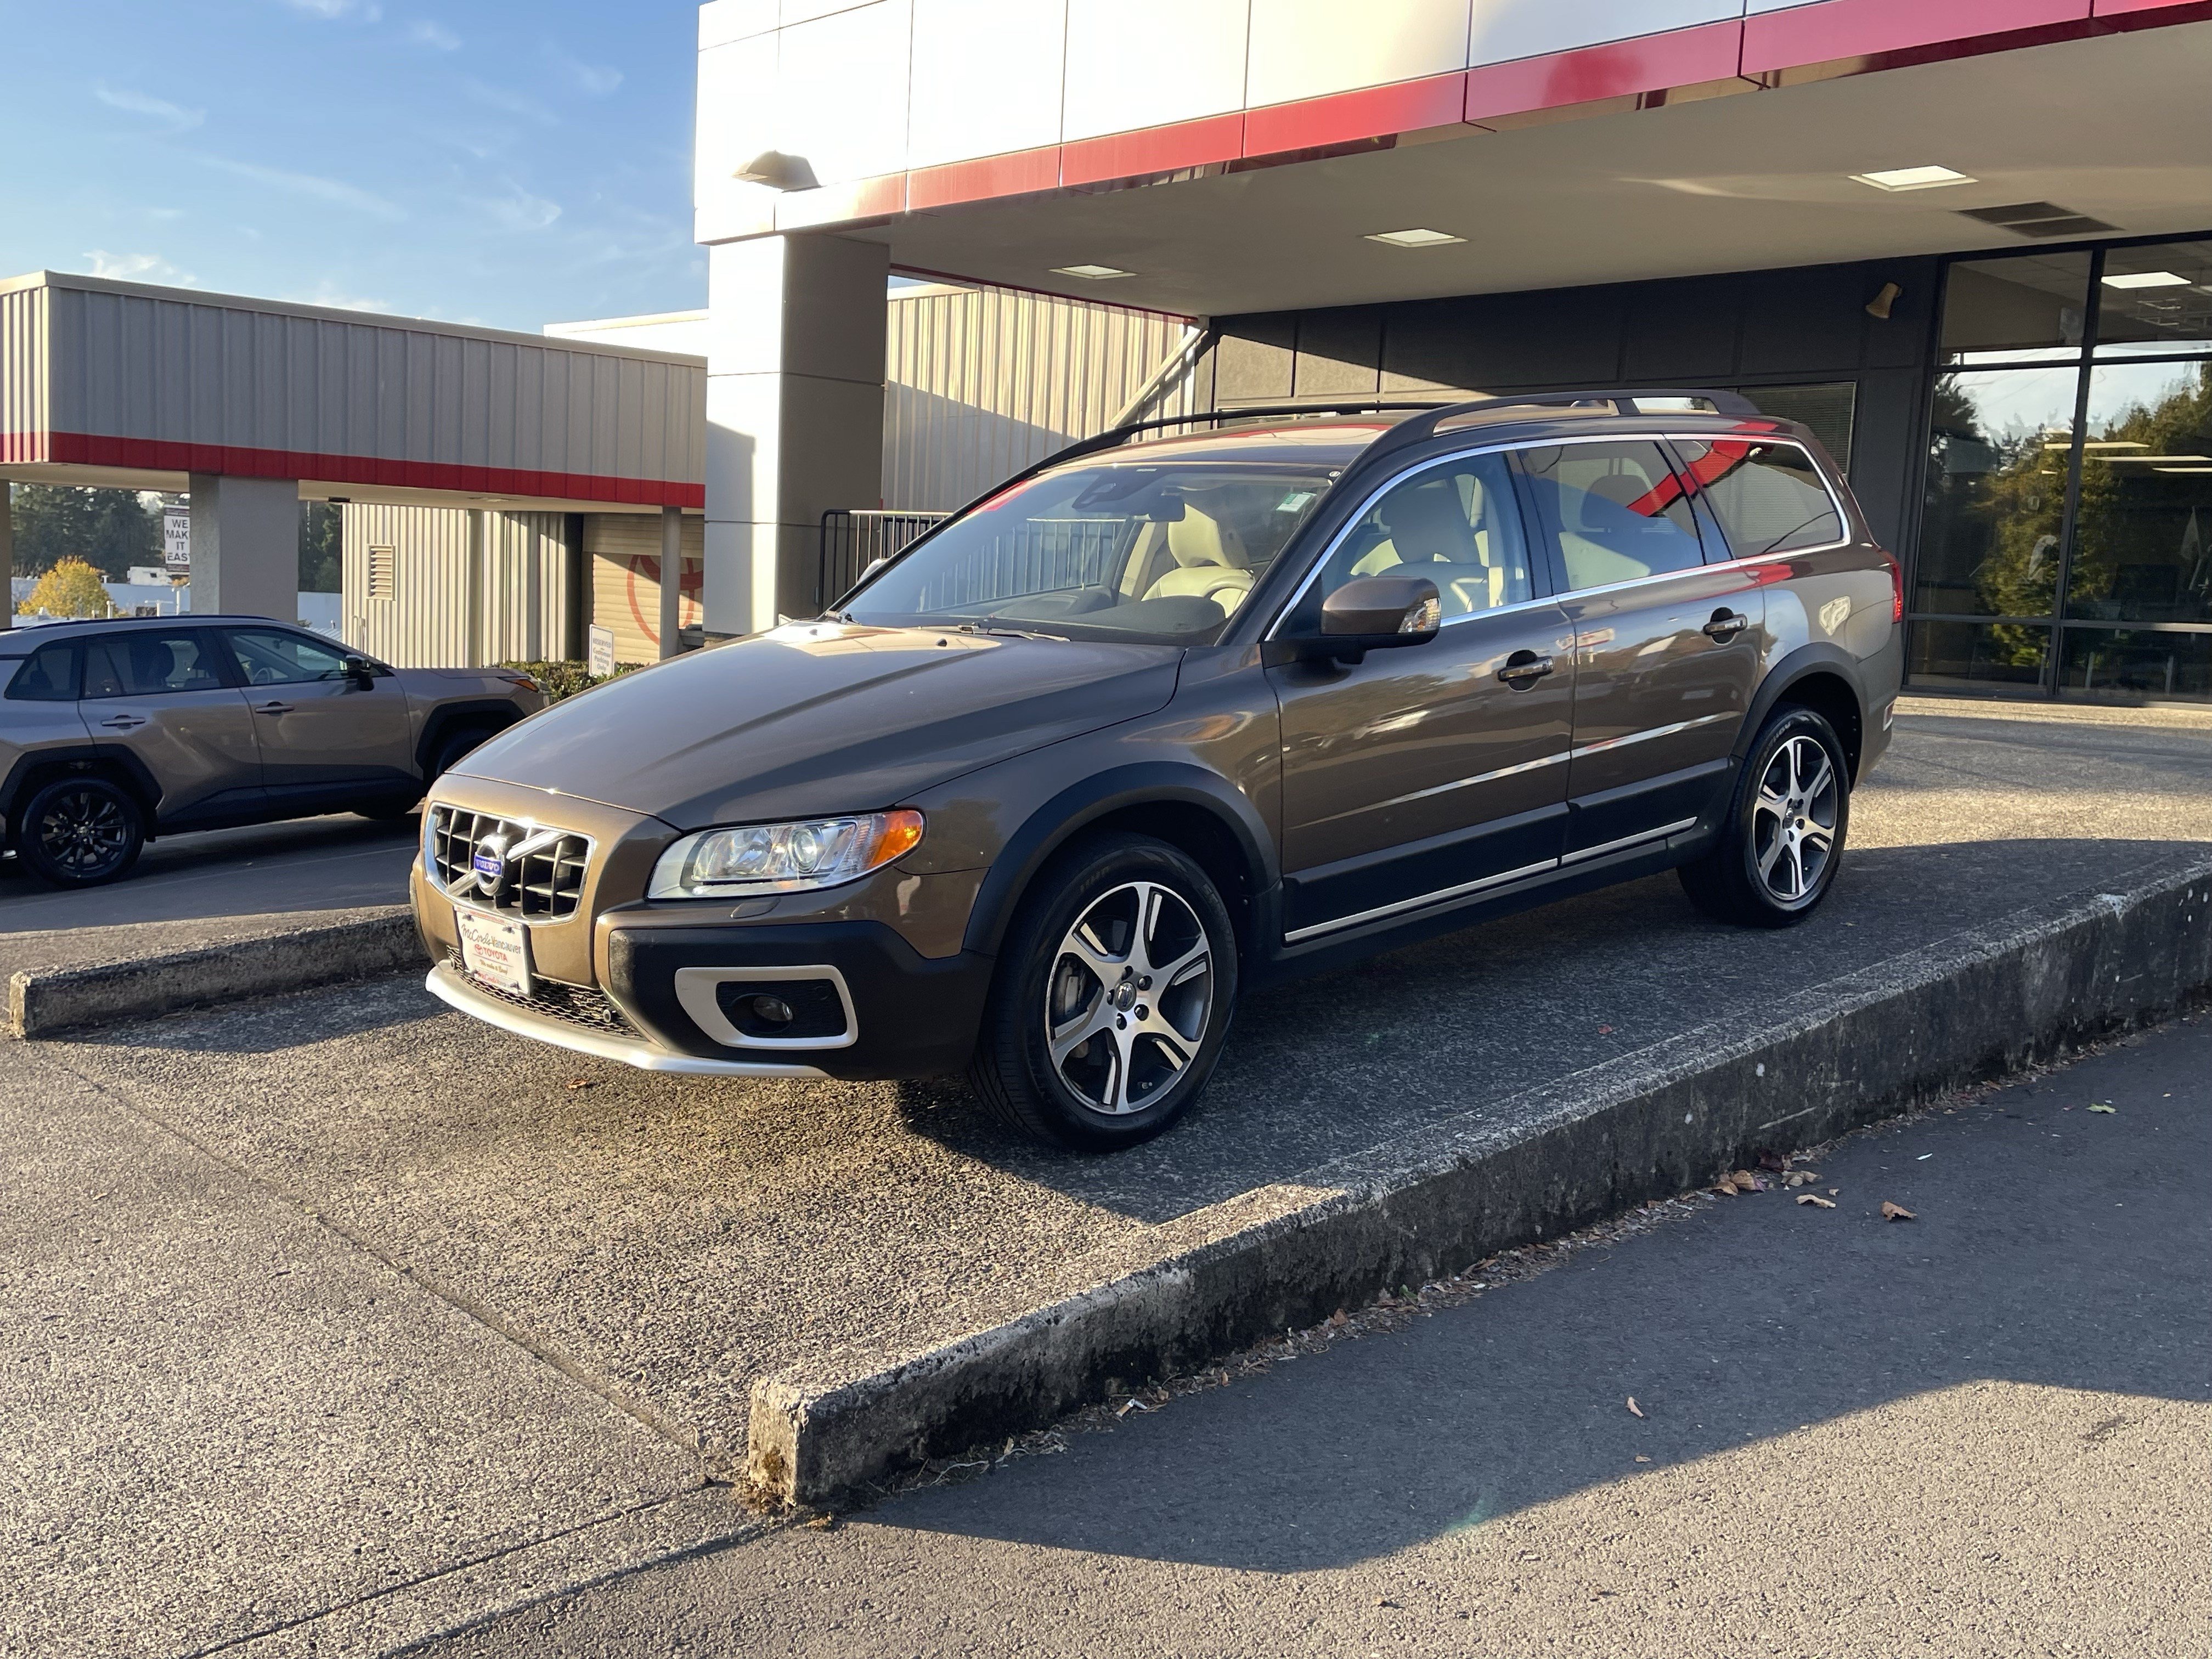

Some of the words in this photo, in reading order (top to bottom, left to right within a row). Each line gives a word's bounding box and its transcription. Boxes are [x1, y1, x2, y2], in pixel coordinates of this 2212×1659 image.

[172, 518, 188, 528] WE
[166, 529, 189, 539] MAK
[176, 541, 185, 550] IT
[167, 552, 190, 561] EAS
[476, 858, 500, 872] VOLVO
[484, 946, 508, 962] TOYOTA
